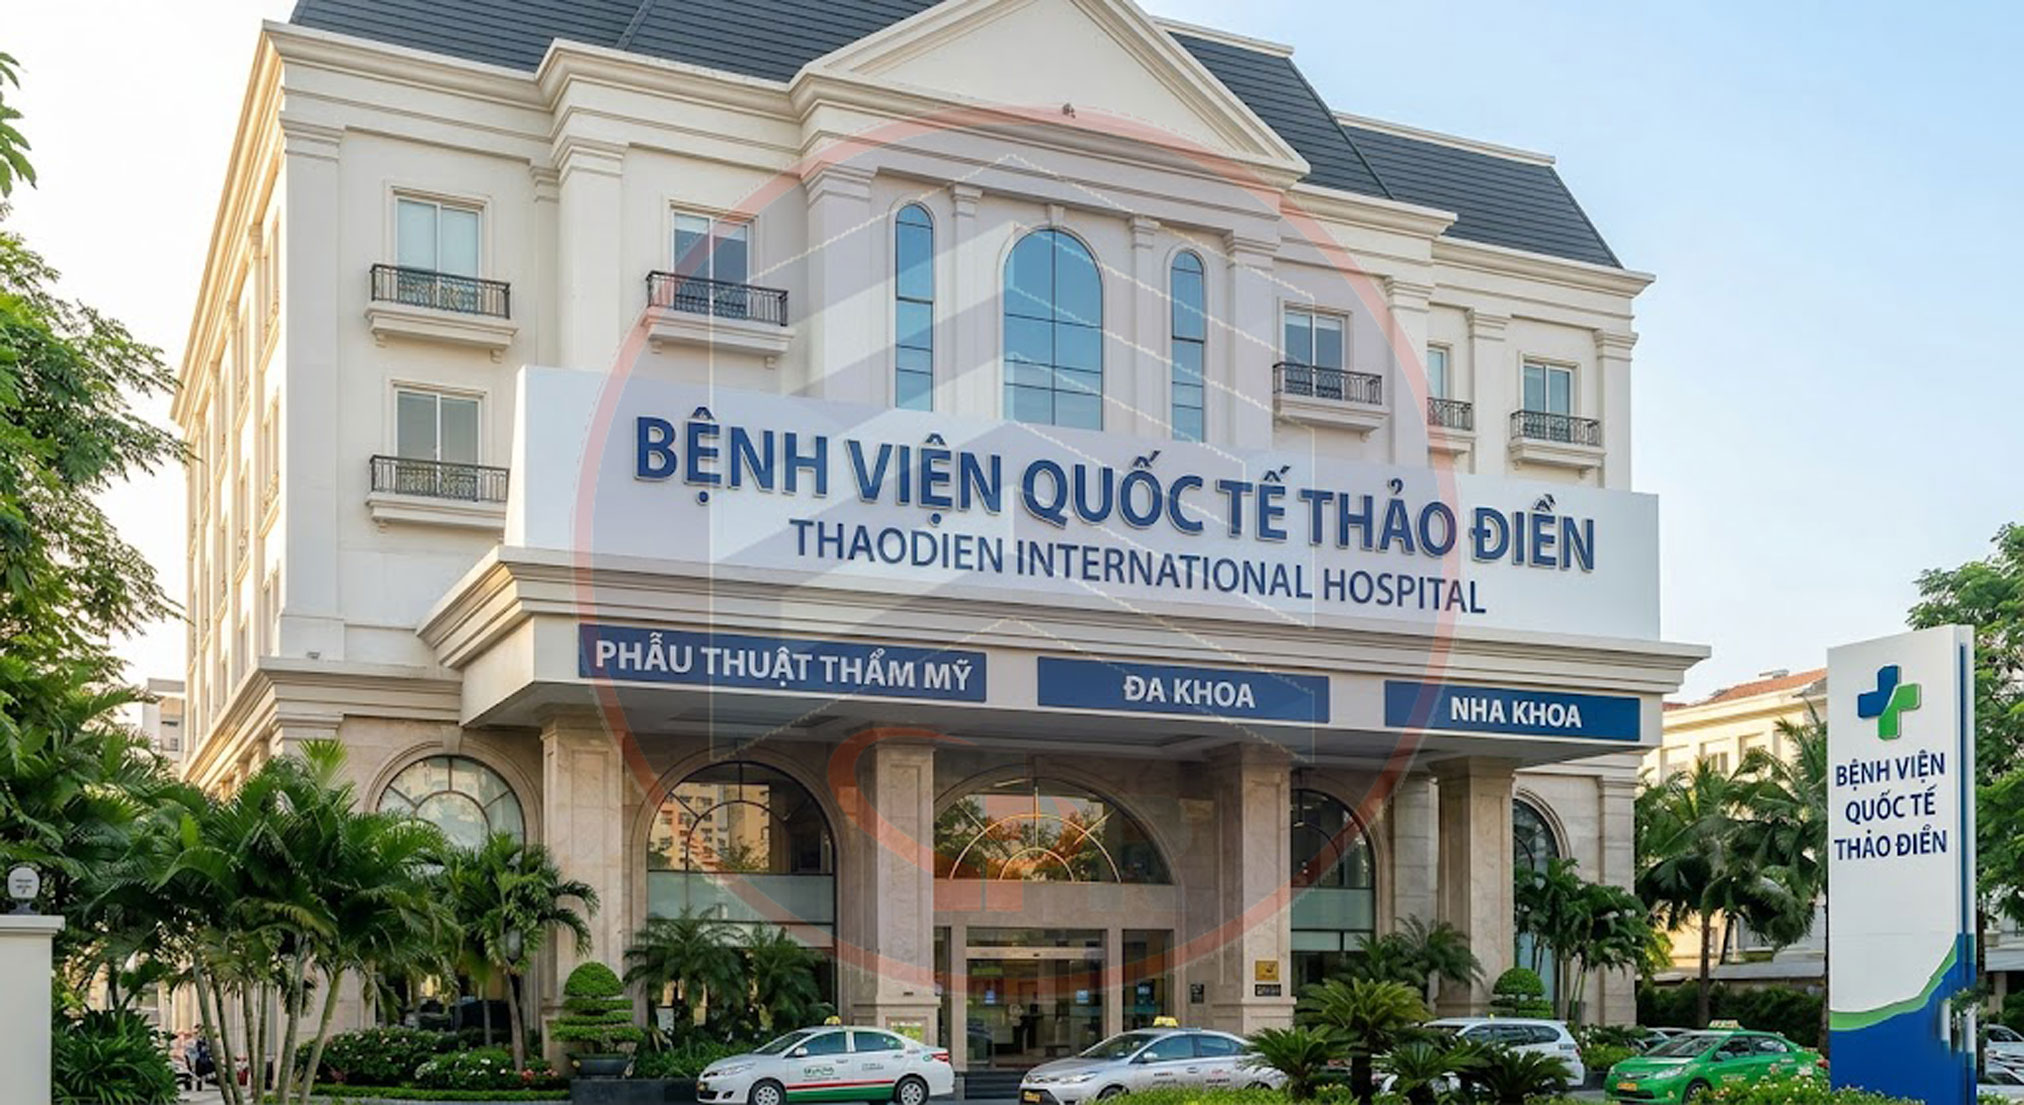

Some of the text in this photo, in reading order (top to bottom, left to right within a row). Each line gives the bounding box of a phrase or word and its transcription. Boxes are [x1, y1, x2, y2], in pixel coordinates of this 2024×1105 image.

[635, 406, 1595, 573] BỆNH VIỆN QUỐC TẾ THẢO ĐIỀN
[789, 518, 1487, 615] THAODIEN INTERNATIONAL HOSPITAL
[596, 631, 973, 692] PHẪU THUẬT THẨM MỸ
[1123, 675, 1256, 709] ĐA KHOA
[1450, 696, 1582, 729] NHA KHOA
[1835, 749, 1945, 791] BỆNH VIỆN
[1845, 789, 1905, 825] QUỐC
